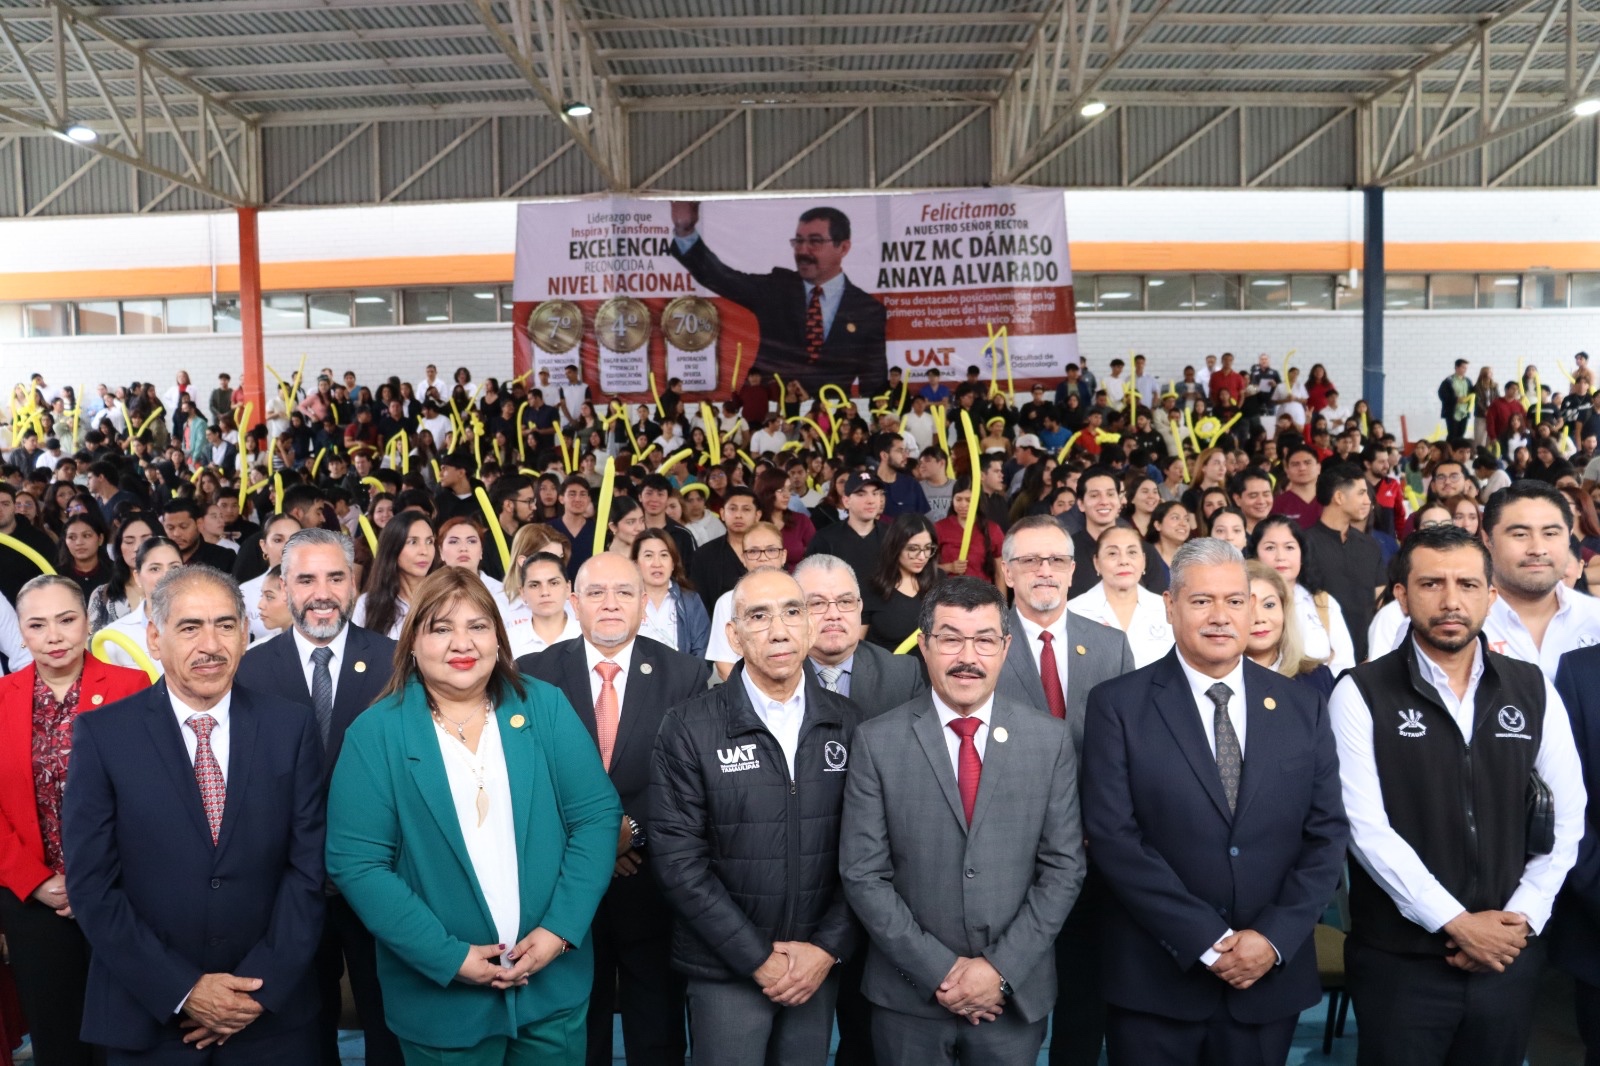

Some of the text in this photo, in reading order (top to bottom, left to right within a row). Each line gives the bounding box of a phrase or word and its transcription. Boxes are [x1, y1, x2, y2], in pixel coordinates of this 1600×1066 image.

[587, 213, 652, 226] Liderazgo que
[921, 202, 1016, 222] Felicitamos
[571, 224, 670, 239] Inspira y Transforma
[905, 219, 1029, 236] A NUESTRO SEÑOR RECTOR
[569, 237, 672, 260] EXCELENCIA
[881, 231, 1053, 263] MVZ MC DÁMASO
[584, 259, 655, 273] RECONOCIDA A
[876, 261, 1058, 288] ANAYA ALVARADO
[548, 272, 697, 296] NIVEL NACIONAL
[884, 296, 898, 306] Por
[901, 298, 911, 306] su
[912, 295, 959, 306] destacado
[1033, 293, 1043, 301] en
[1044, 291, 1056, 301] los
[886, 307, 926, 319] primeros
[927, 305, 961, 318] lugares
[962, 304, 976, 315] del
[978, 303, 1014, 315] Ranking
[672, 313, 712, 336] 70%
[911, 319, 923, 328] de
[925, 317, 963, 327] Rectores
[965, 316, 977, 326] de
[978, 314, 1009, 324] México
[905, 347, 956, 367] UAT
[716, 743, 757, 765] UAT
[721, 763, 761, 773] TAMAULIPAS
